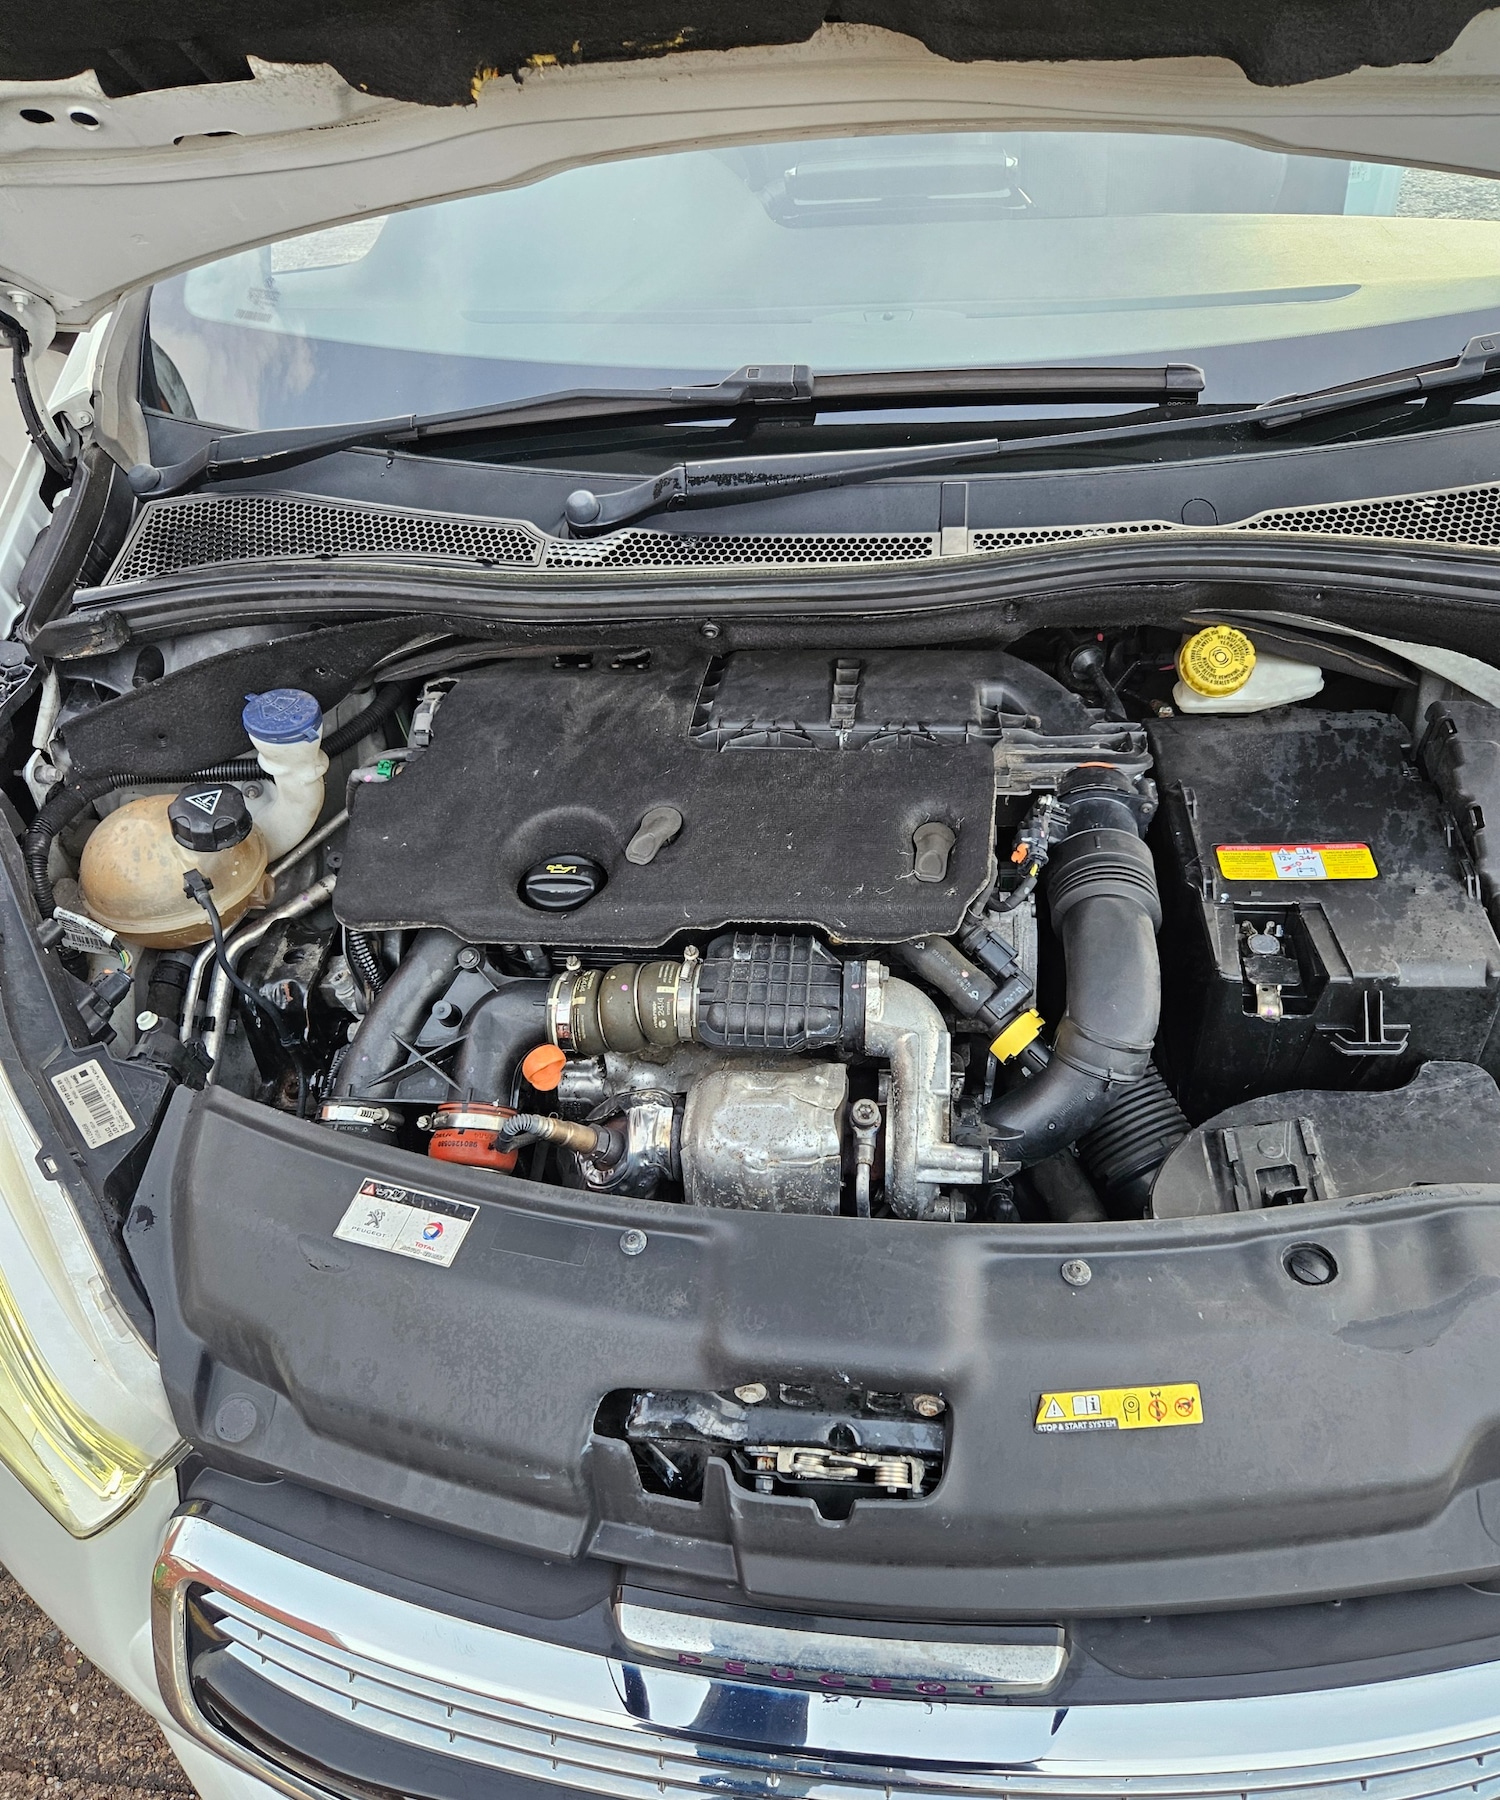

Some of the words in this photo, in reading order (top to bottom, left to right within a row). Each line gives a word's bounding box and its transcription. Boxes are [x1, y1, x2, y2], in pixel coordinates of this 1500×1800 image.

[352, 1226, 386, 1238] PEUGEOT
[415, 1241, 435, 1251] TOTAL
[1065, 1421, 1088, 1430] START
[1088, 1420, 1116, 1428] SYSTEM
[678, 1653, 993, 1697] PEUGEOT
